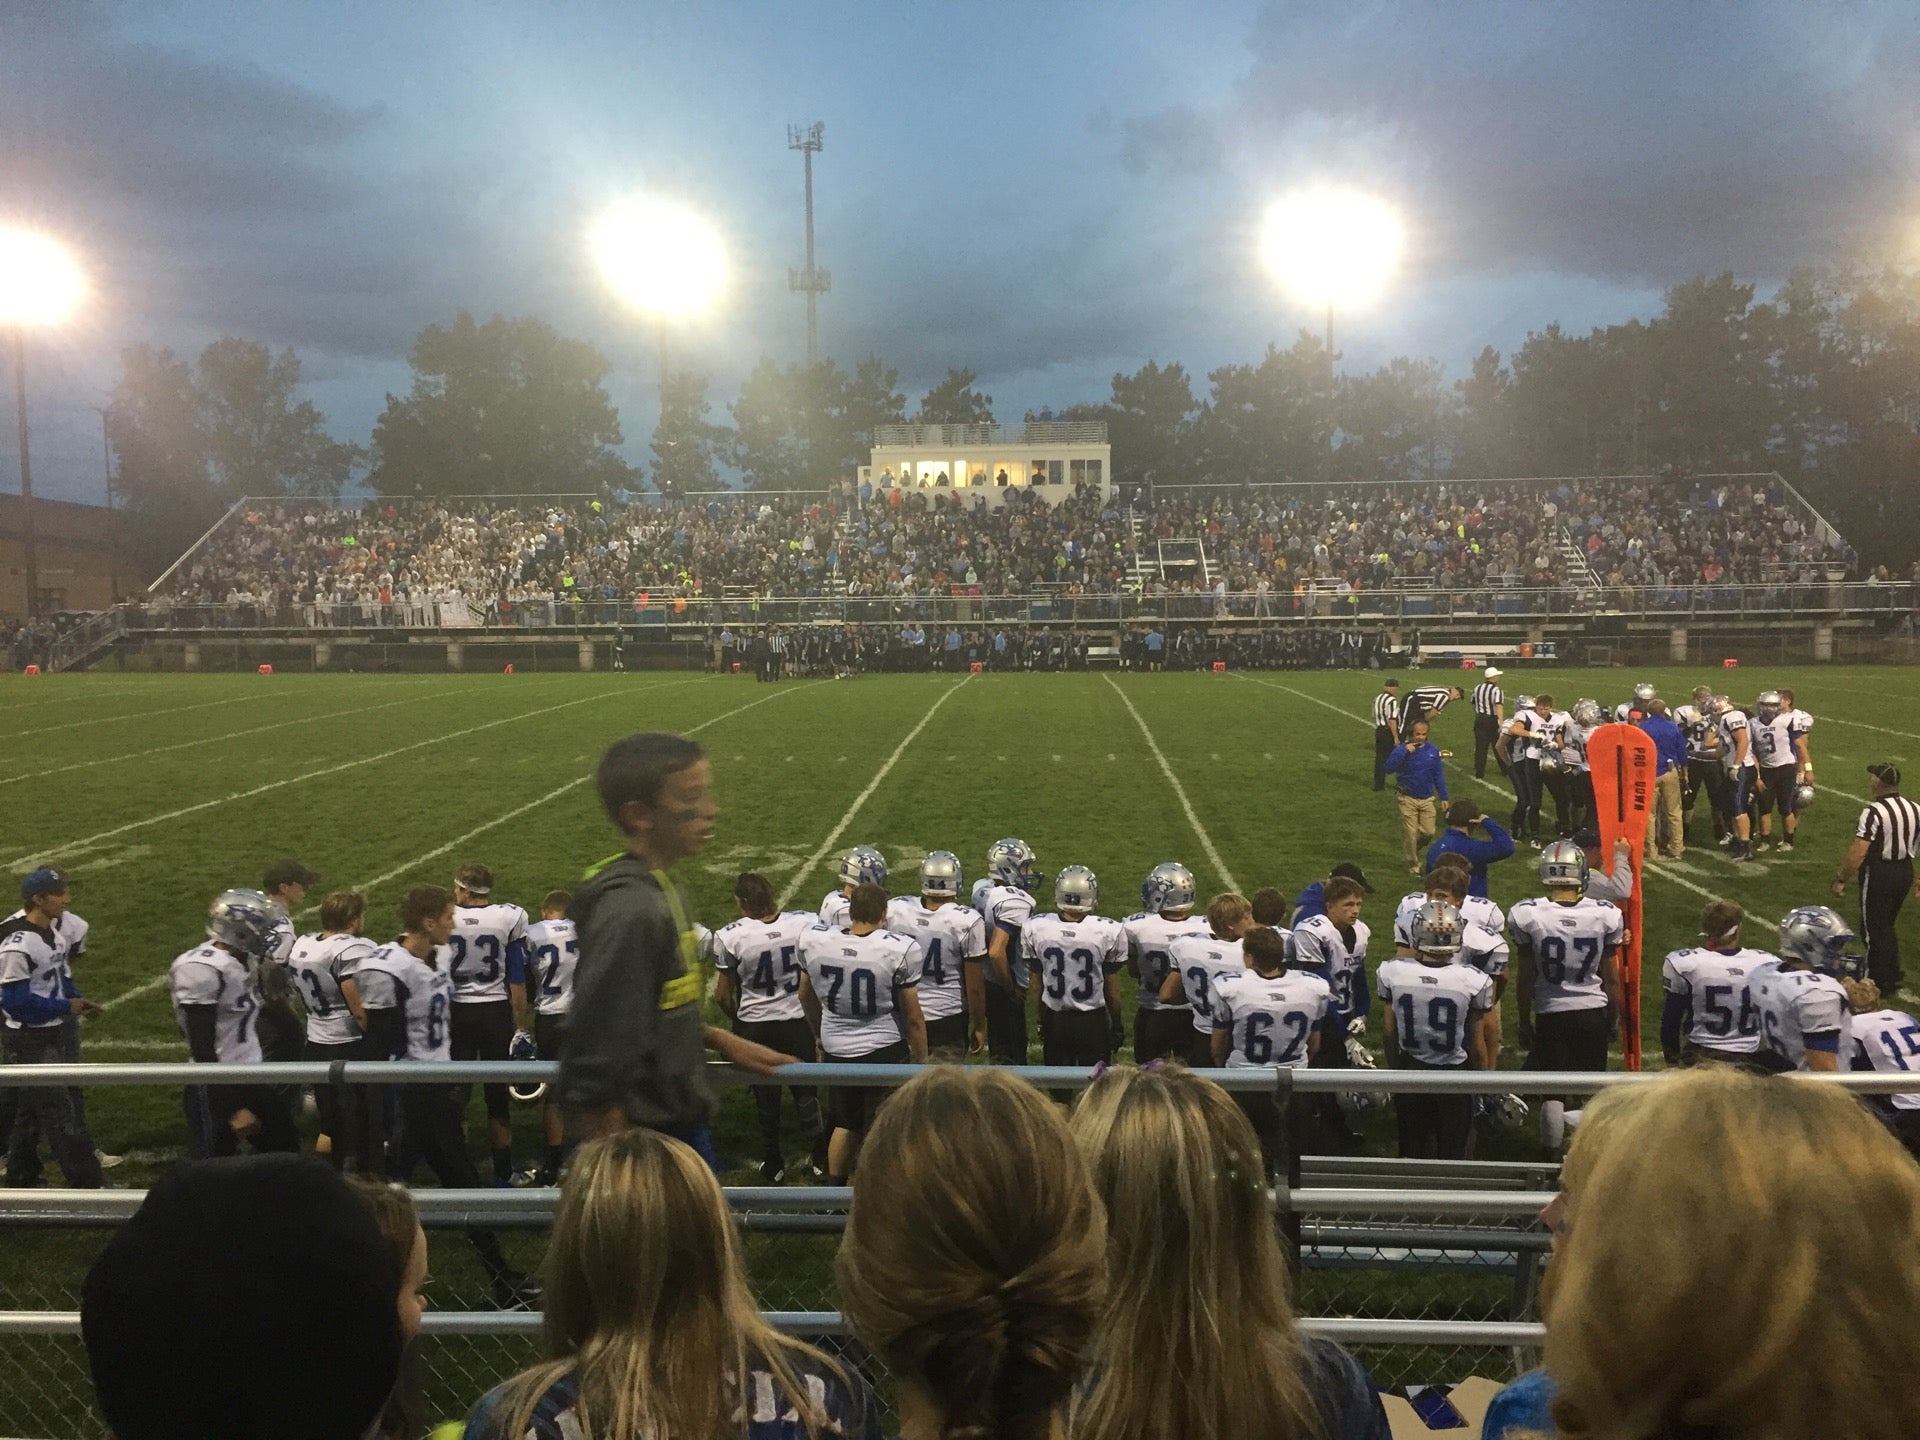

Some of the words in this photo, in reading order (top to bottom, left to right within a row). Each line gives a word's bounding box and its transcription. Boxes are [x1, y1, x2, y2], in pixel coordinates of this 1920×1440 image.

[1633, 746, 1646, 773] PRO
[1633, 781, 1646, 811] DOWN
[1549, 866, 1567, 877] 87
[450, 934, 501, 983] 23
[752, 944, 801, 997] 45
[1043, 946, 1094, 1002] 33
[1540, 935, 1598, 984] 87
[820, 963, 877, 1018] 70
[1243, 1010, 1309, 1064] 62
[1398, 992, 1458, 1050] 19
